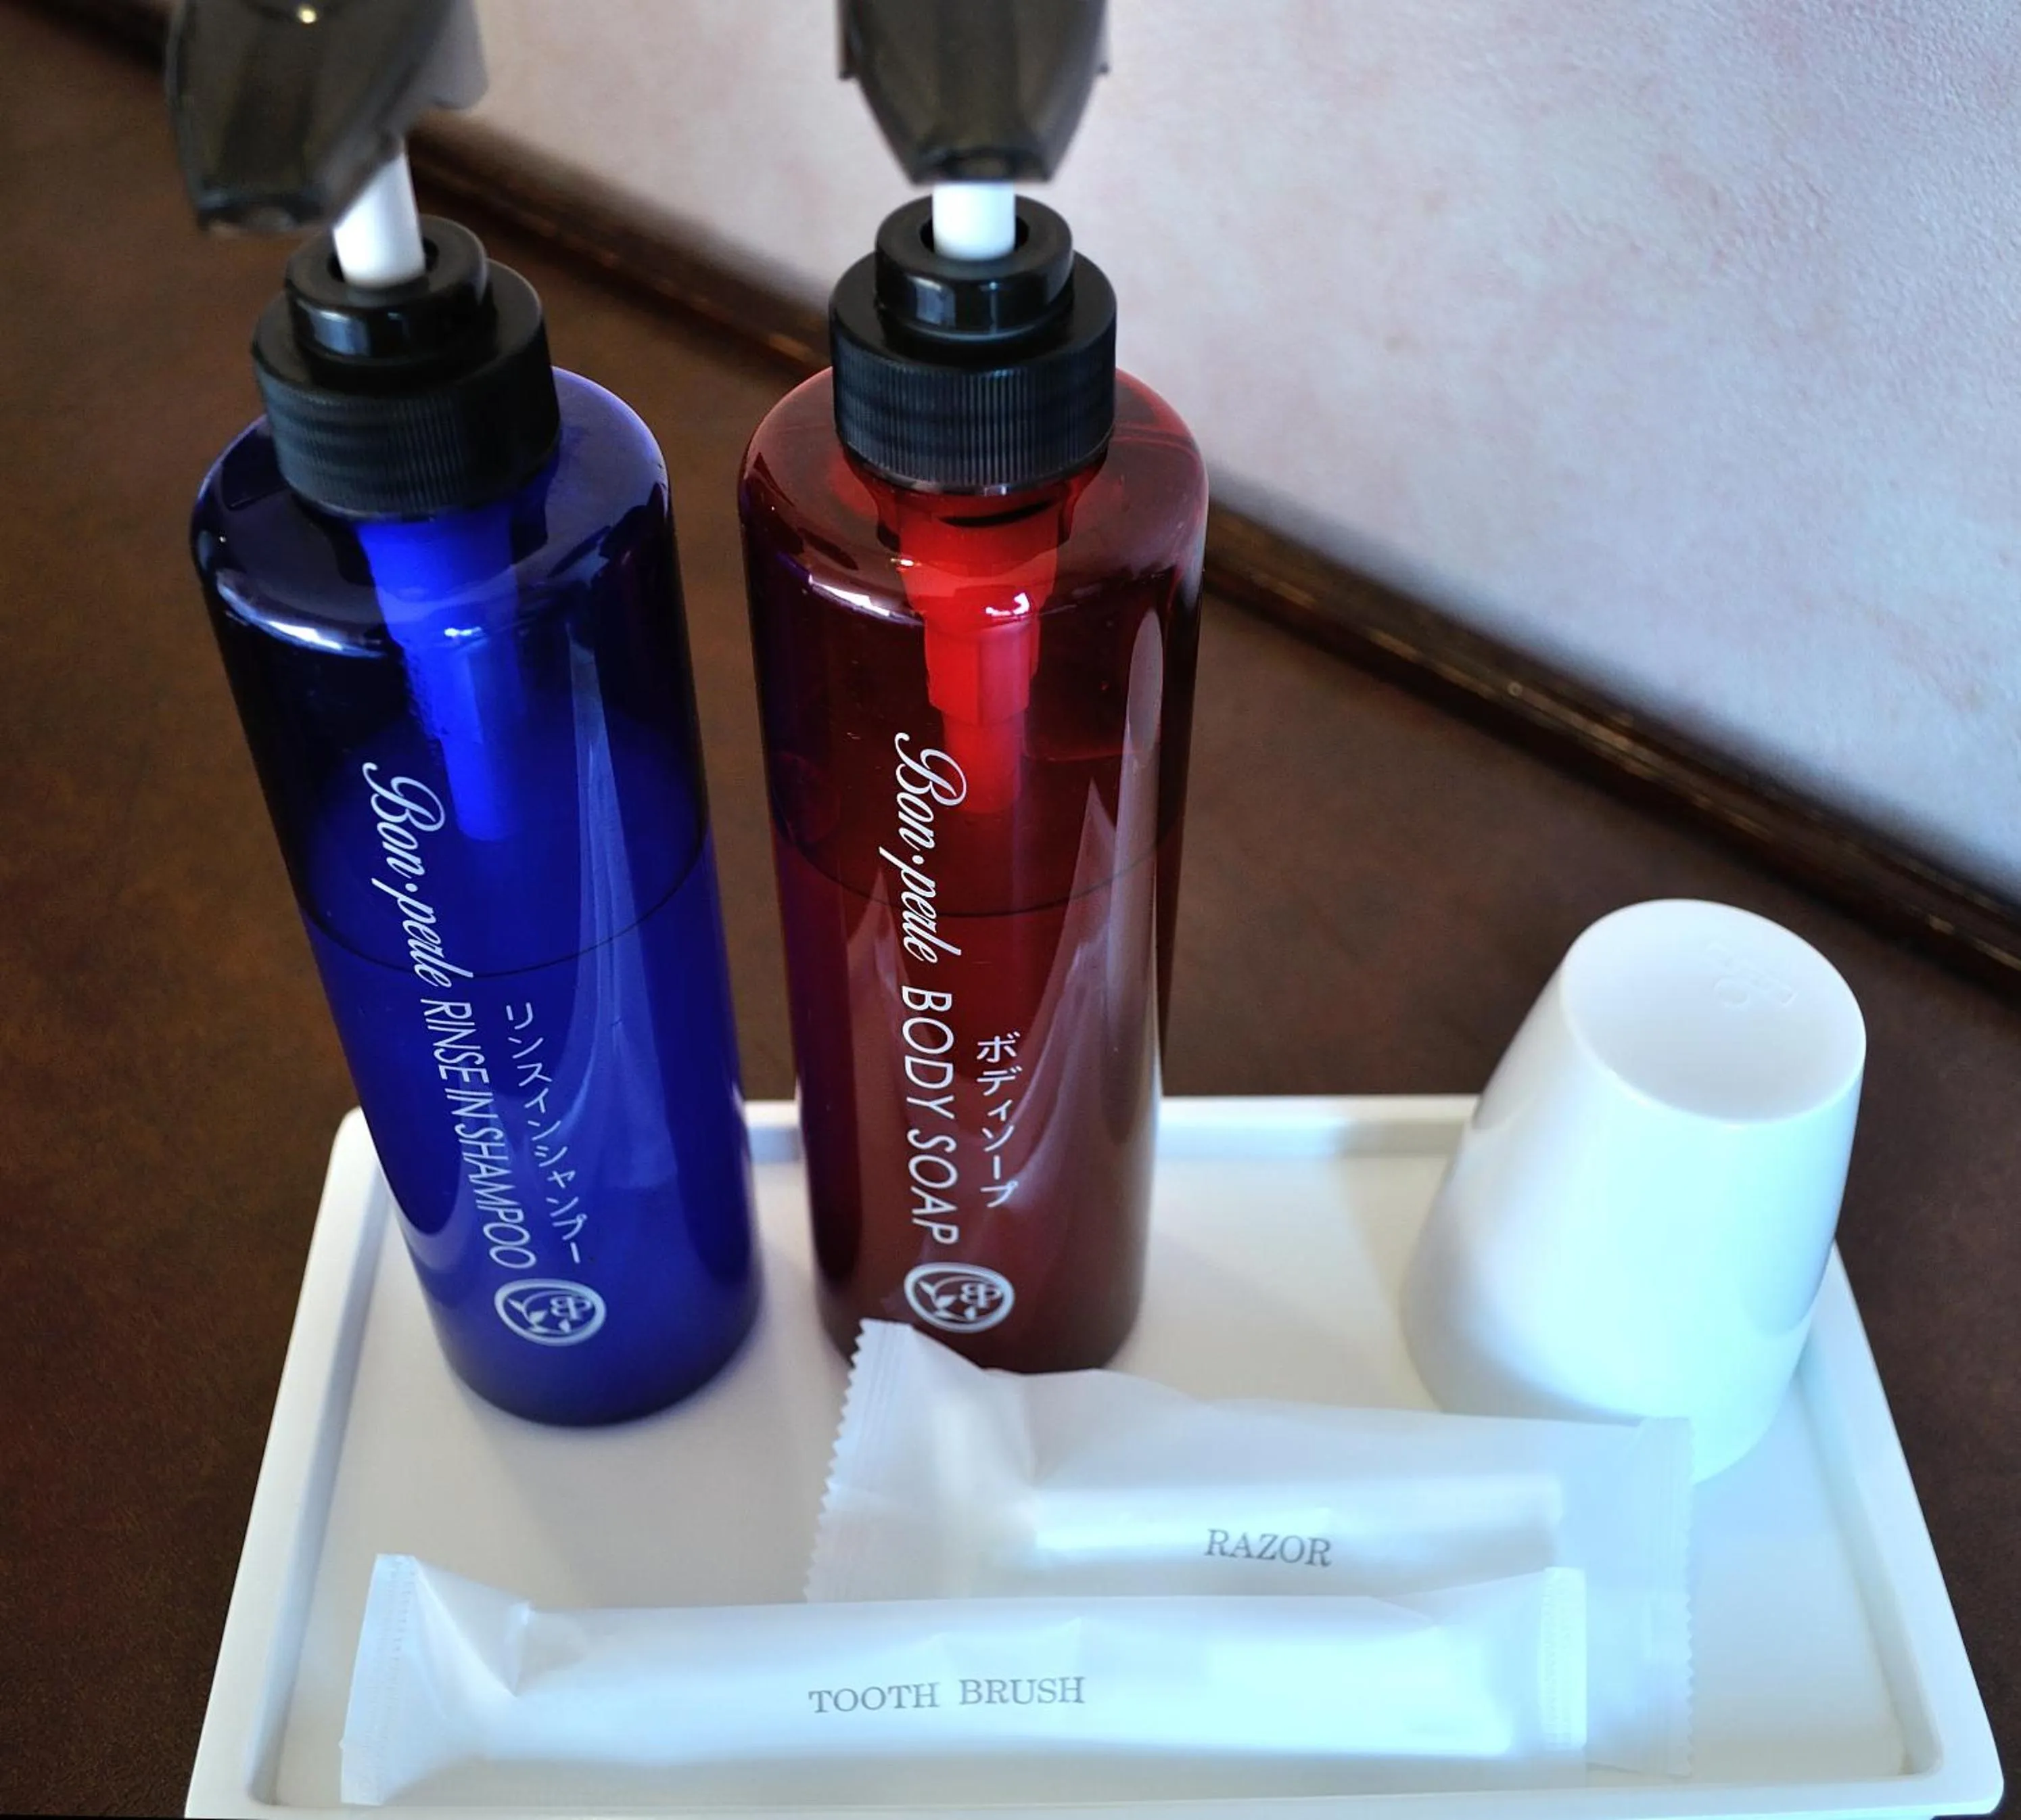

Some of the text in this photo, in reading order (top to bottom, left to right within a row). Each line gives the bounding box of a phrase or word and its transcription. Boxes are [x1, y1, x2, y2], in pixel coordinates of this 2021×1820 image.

[420, 998, 490, 1084] RINSE
[902, 985, 955, 1120] BODY
[444, 1088, 498, 1119] IN
[506, 1002, 587, 1263] リンスインシャンプー
[976, 1031, 1023, 1208] ボディソープ
[455, 1123, 536, 1269] SHAMPOO
[906, 1127, 959, 1244] SOAP
[1204, 1528, 1332, 1567] RAZOR
[808, 1676, 1086, 1713] TOOTH BRUSH
